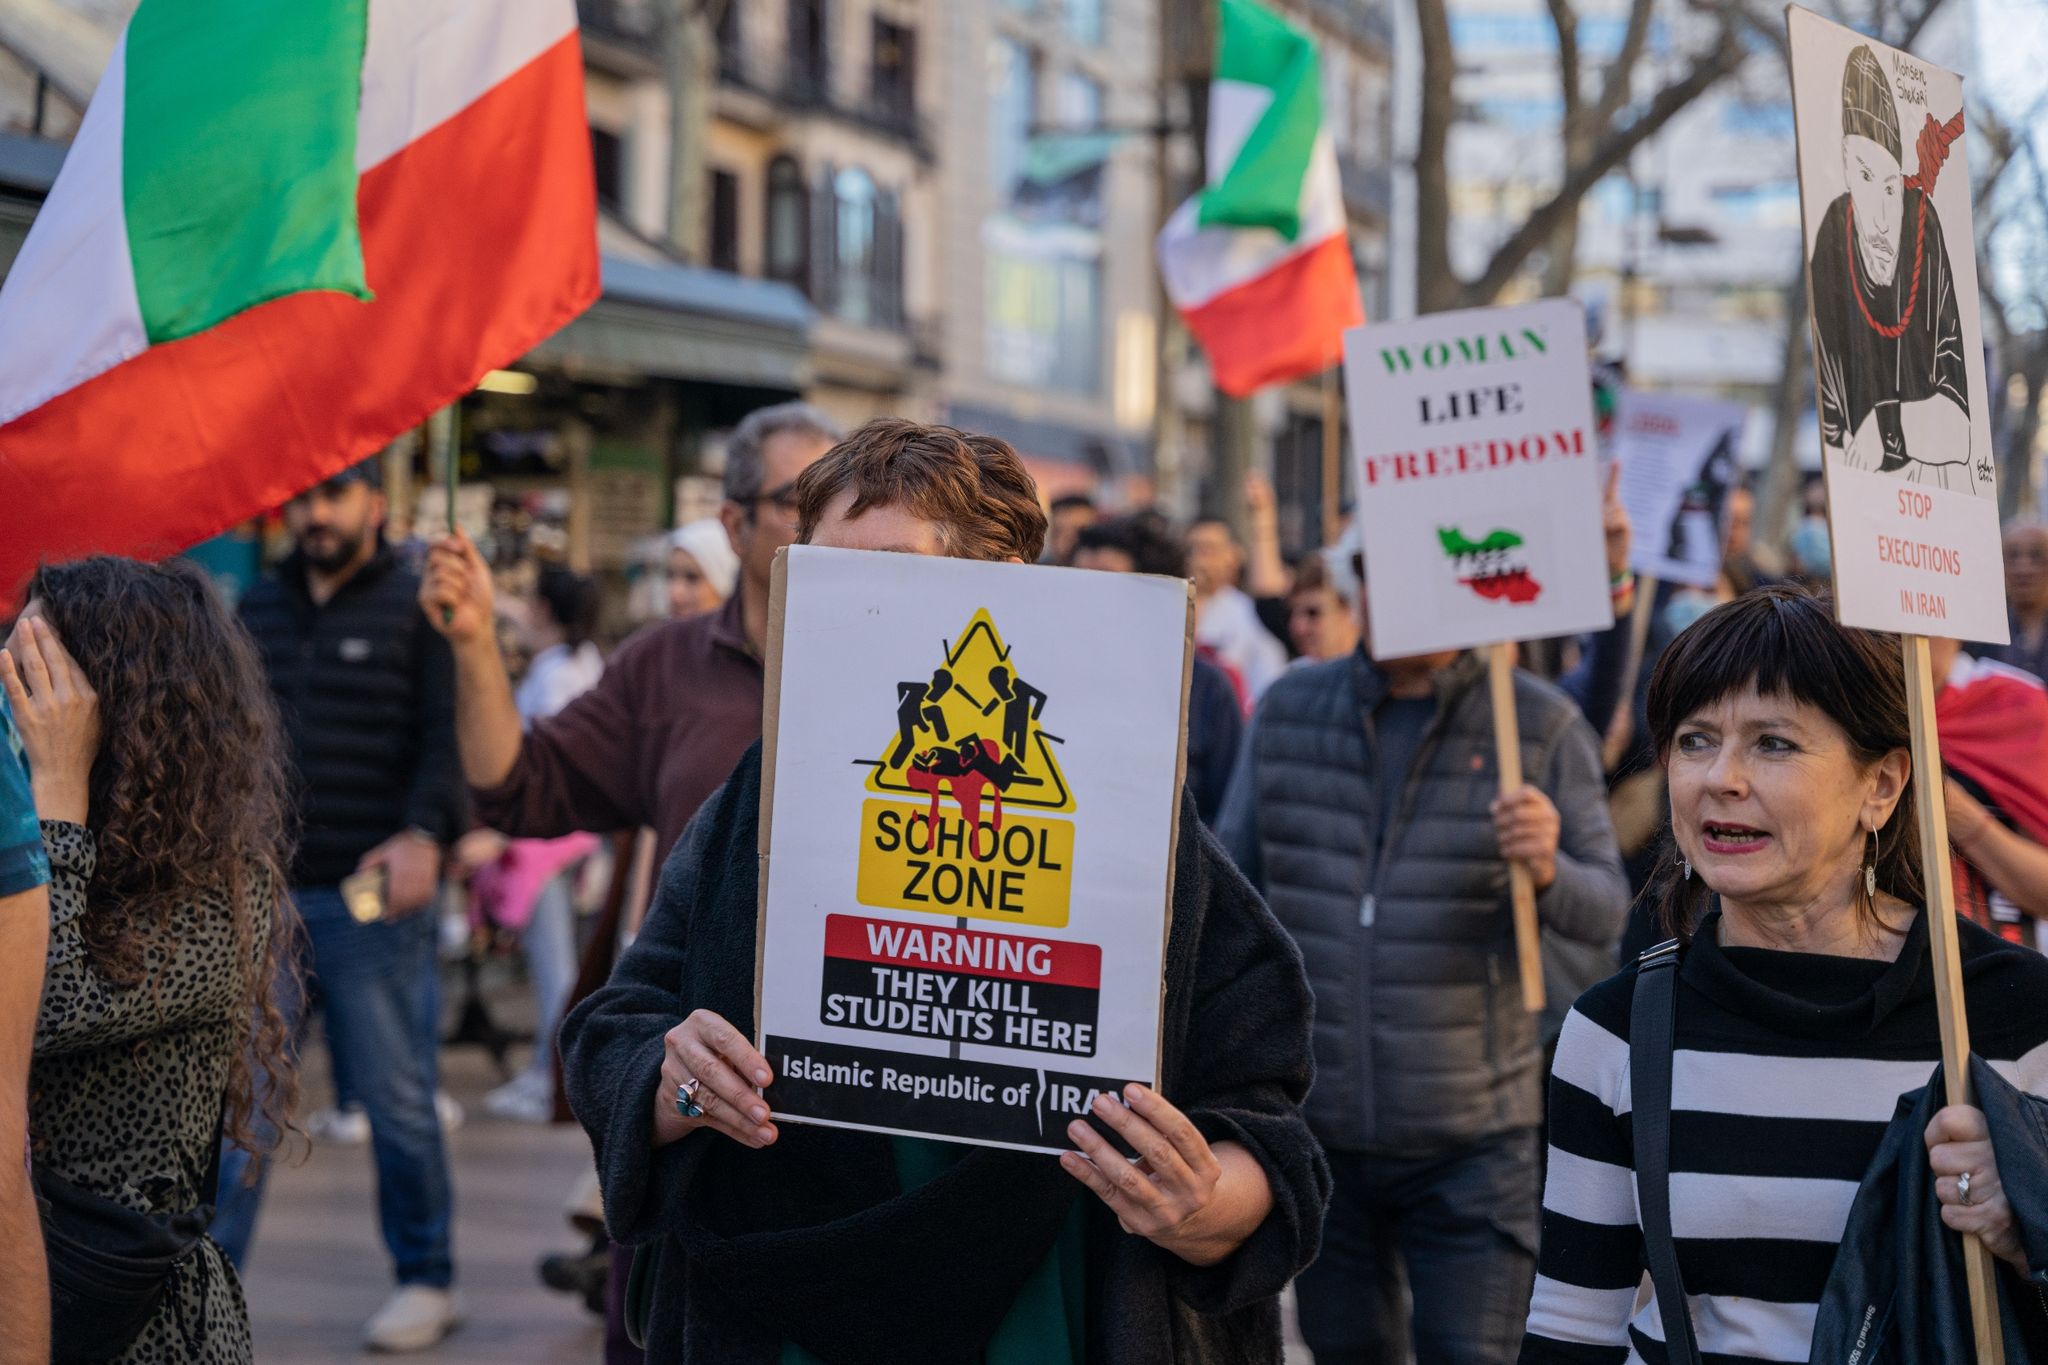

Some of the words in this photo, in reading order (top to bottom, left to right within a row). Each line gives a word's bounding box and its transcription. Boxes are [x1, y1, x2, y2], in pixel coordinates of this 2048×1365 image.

[1892, 51, 1927, 86] Mohsen
[1379, 327, 1548, 373] WOMAN
[1417, 382, 1524, 424] LIFE
[1365, 430, 1585, 484] FREEDOM
[1898, 489, 1932, 520] STOP
[1878, 535, 1960, 576] EXECUTIONS
[1900, 589, 1914, 615] IN
[1917, 592, 1946, 620] IRAN
[874, 810, 1062, 871] SCHOOL
[902, 860, 1026, 913] ZONE
[866, 923, 1052, 976] WARNING
[871, 967, 960, 1005] THEY
[967, 979, 1038, 1015] KILL
[825, 994, 994, 1041] STUDENTS
[1004, 1015, 1093, 1054] HERE
[782, 1054, 874, 1088] Islamic
[881, 1067, 995, 1103] Republic
[1002, 1082, 1031, 1108] of
